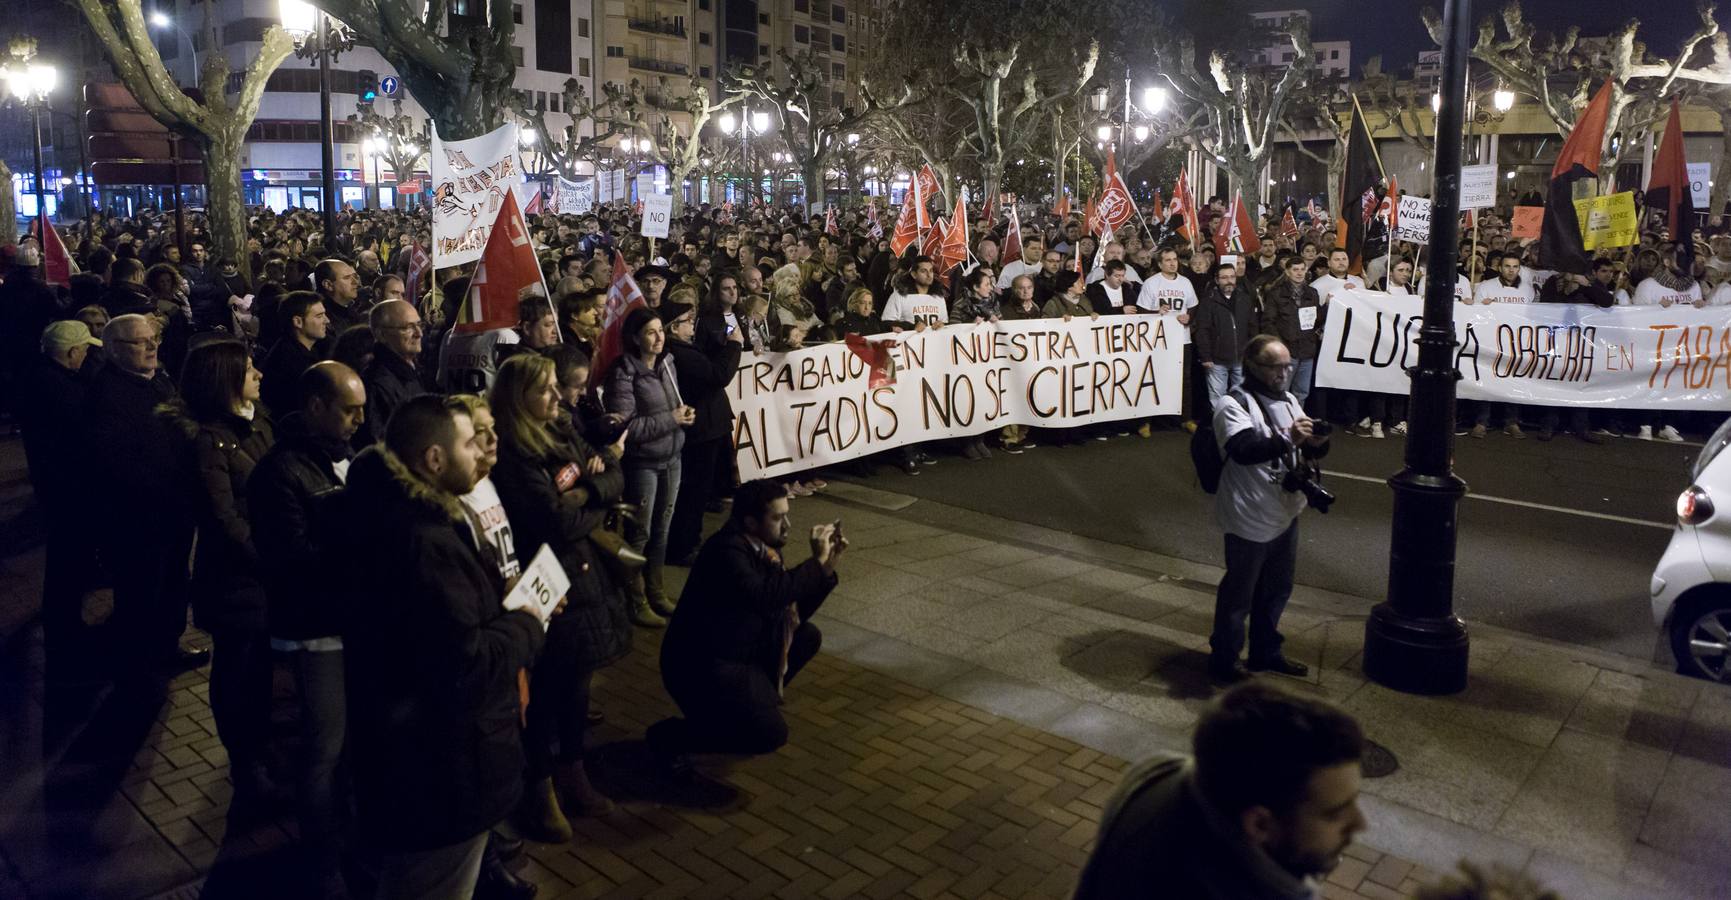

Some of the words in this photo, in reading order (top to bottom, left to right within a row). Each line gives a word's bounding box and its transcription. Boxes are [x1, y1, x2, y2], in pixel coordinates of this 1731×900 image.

[1402, 199, 1418, 211] NO
[649, 211, 665, 223] NO
[1158, 289, 1185, 298] ALTADIS
[1159, 298, 1184, 310] NO
[1493, 296, 1525, 304] ALTADIS
[1336, 307, 1480, 382] LUCA
[1494, 324, 1597, 383] OBRERA
[1606, 342, 1635, 371] EN
[736, 351, 864, 400] TRABAJO
[951, 331, 1080, 365] NUESTRA
[1091, 319, 1168, 355] TIERRA
[733, 386, 898, 469] ALTADIS
[921, 373, 975, 430] NO
[985, 367, 1011, 421] SE
[1026, 355, 1160, 418] CIERRA
[531, 576, 551, 606] NO
